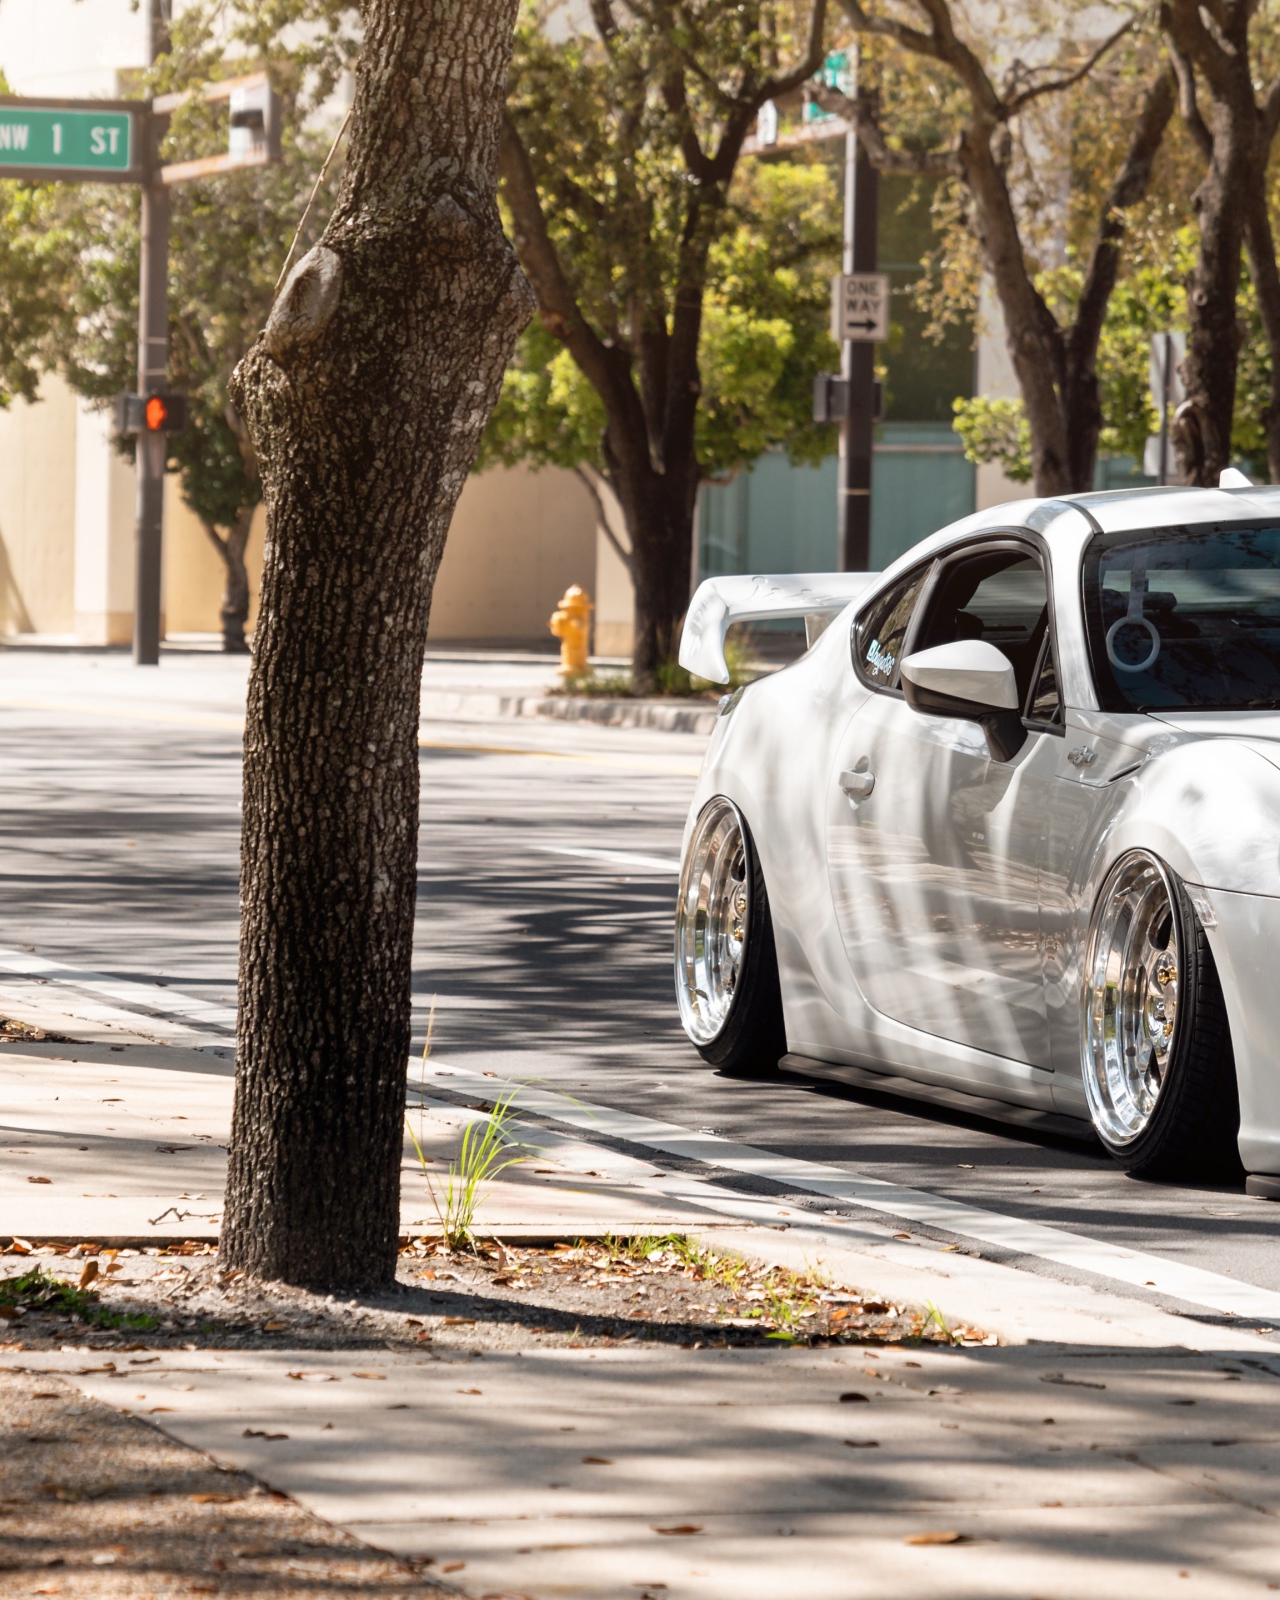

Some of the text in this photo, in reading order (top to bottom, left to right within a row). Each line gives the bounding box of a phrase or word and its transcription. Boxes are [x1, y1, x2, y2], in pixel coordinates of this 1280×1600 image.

[0, 123, 120, 155] NW 1 ST
[846, 281, 880, 297] ONE
[845, 299, 882, 314] WAY
